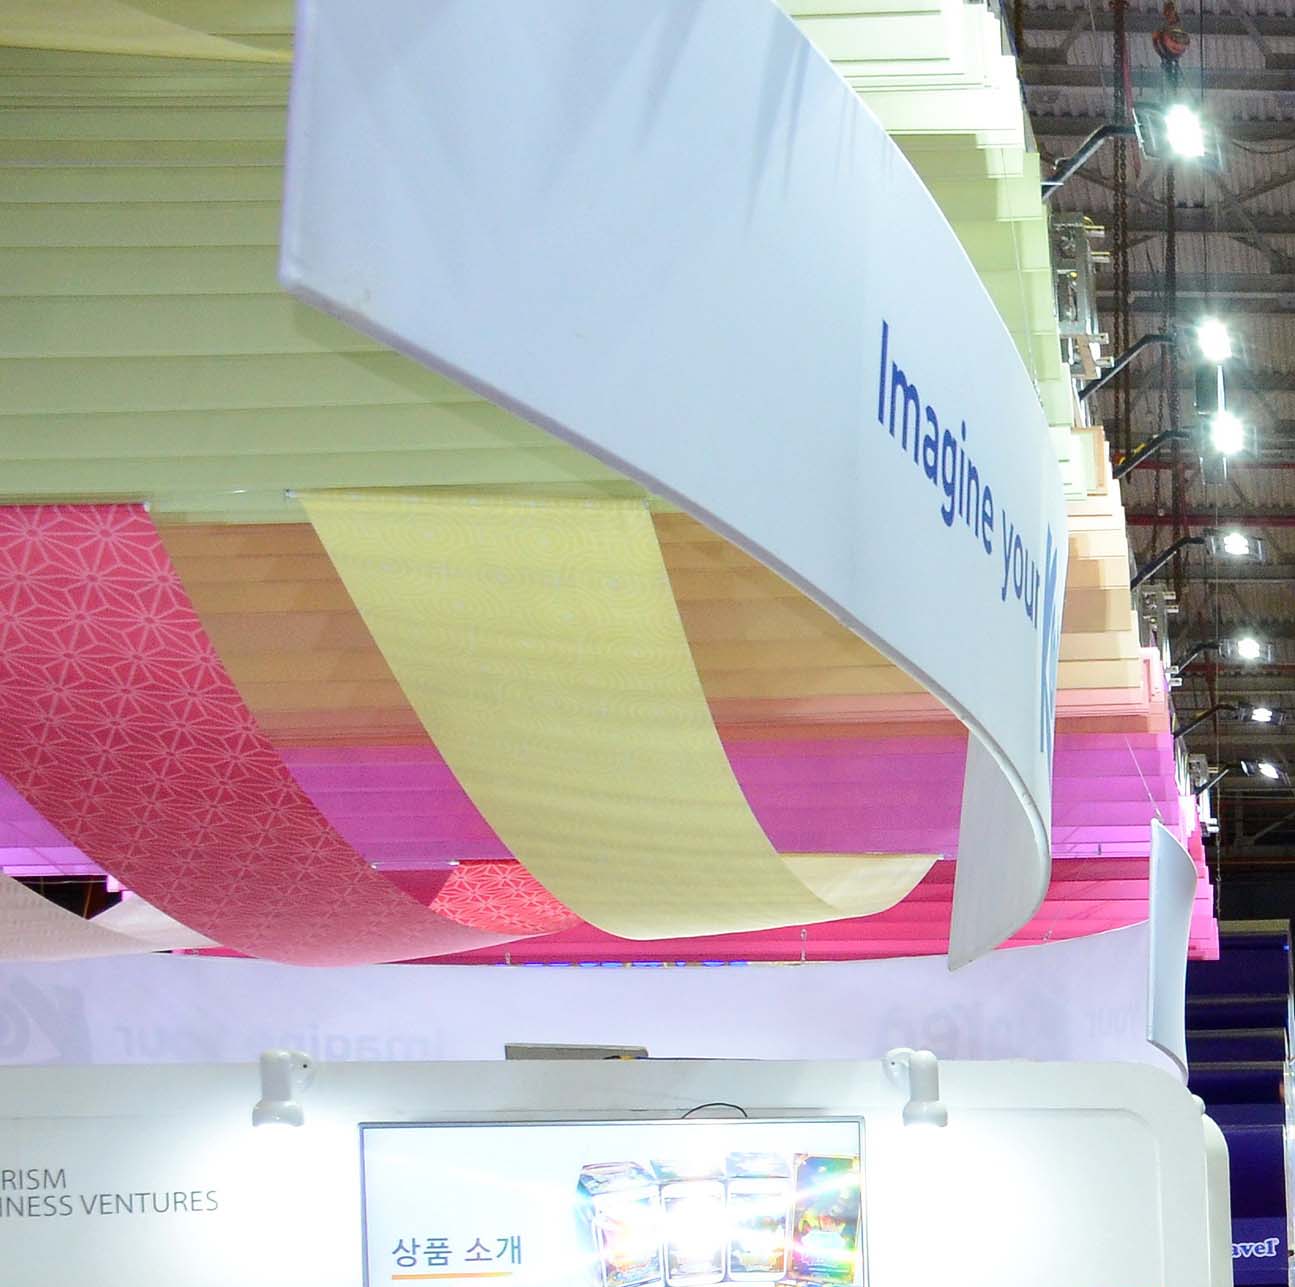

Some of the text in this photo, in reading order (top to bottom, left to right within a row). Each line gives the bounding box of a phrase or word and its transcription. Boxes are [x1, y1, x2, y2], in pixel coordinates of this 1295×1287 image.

[877, 319, 1041, 629] Imagine your
[80, 1190, 219, 1215] VENTURES
[391, 1235, 522, 1267] 상품 소개
